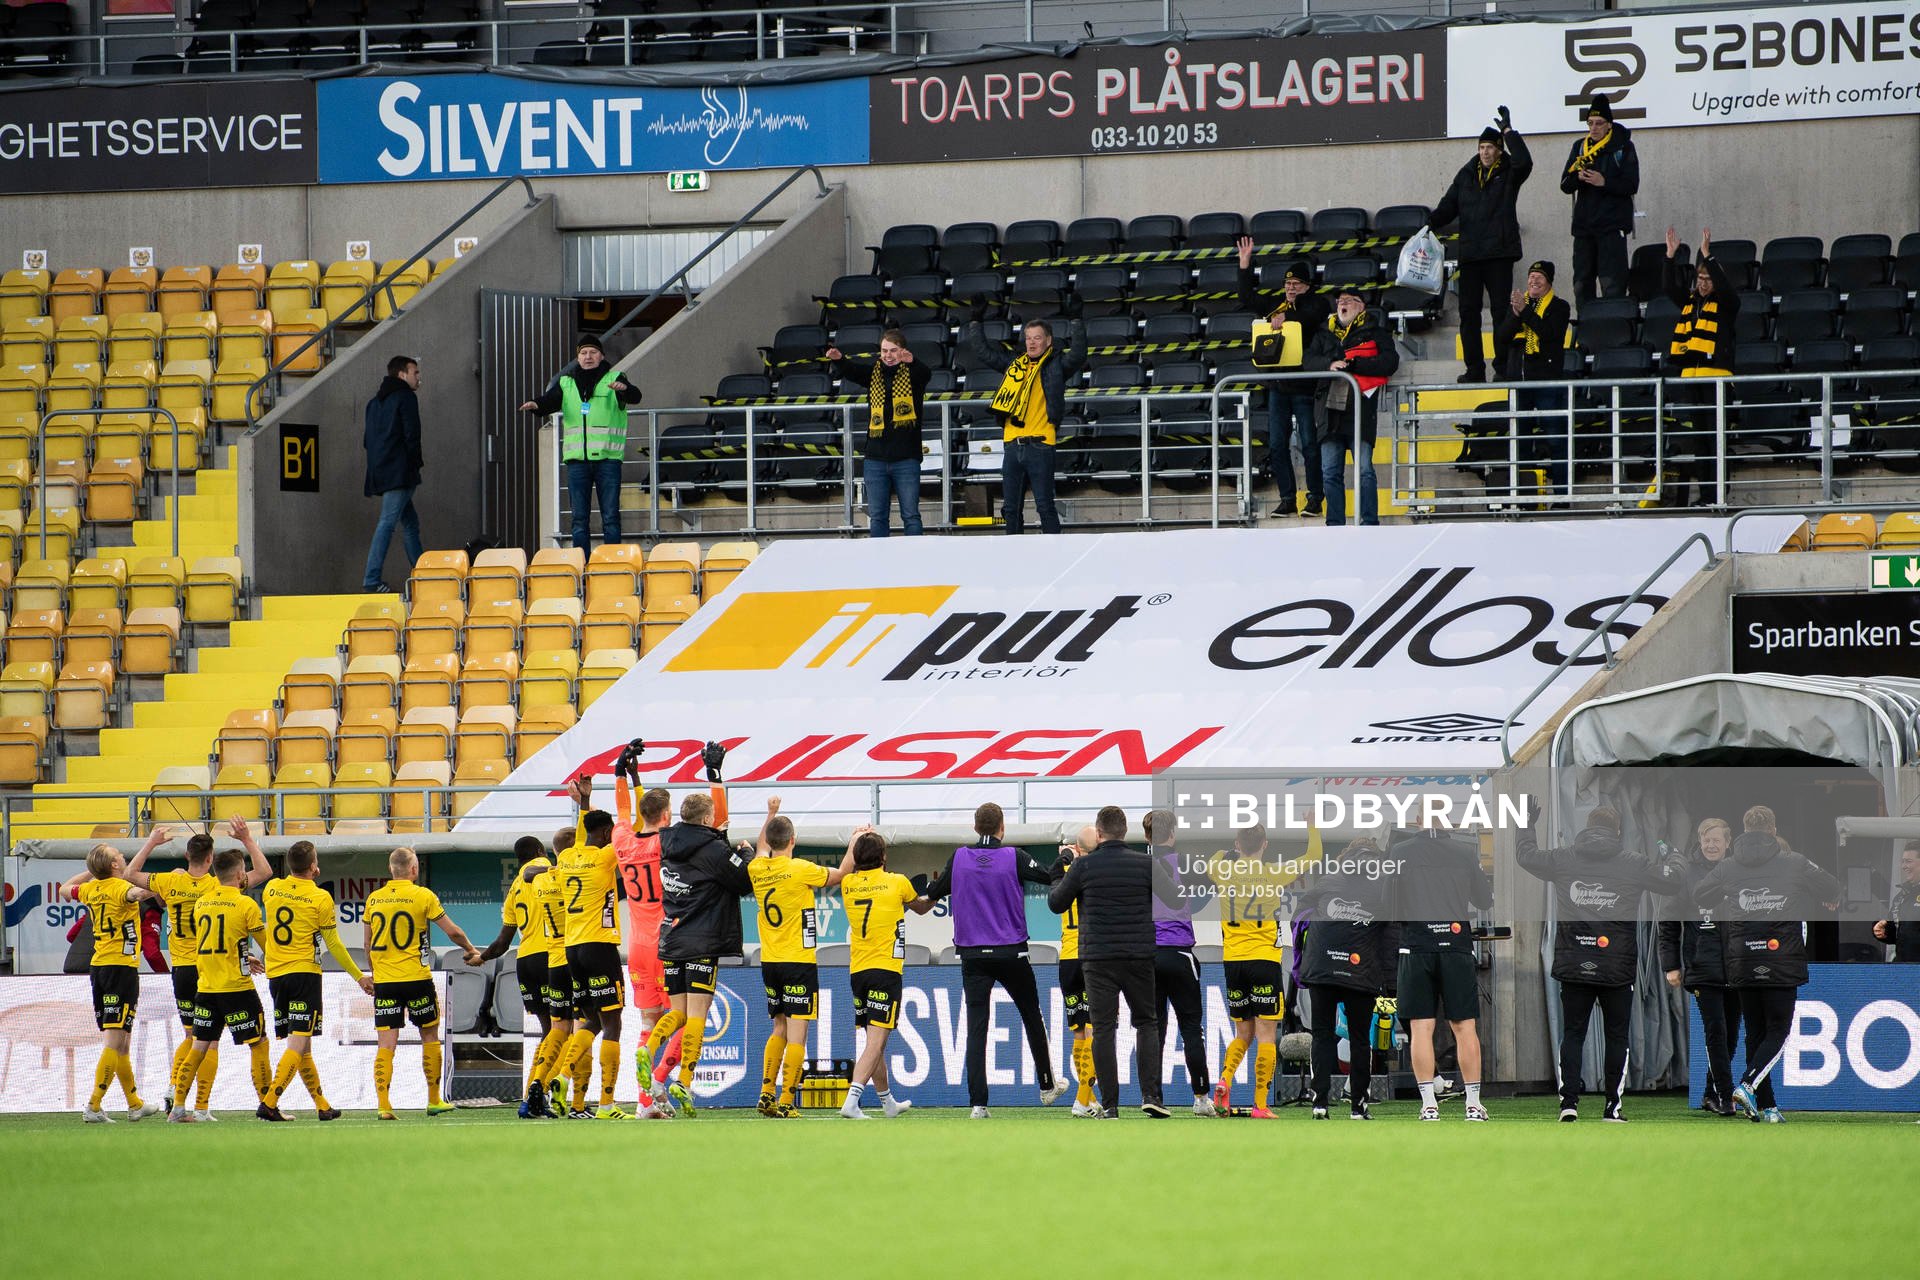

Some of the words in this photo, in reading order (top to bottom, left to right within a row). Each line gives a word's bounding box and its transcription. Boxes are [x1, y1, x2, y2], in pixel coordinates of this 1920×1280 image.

[891, 70, 1075, 124] TOARPS
[1096, 47, 1426, 116] PLÅTSLAGERI
[1692, 87, 1780, 116] Upgrade
[1785, 85, 1831, 106] with
[1836, 81, 1920, 103] comfort
[0, 113, 302, 160] GHETSSERVICE
[377, 81, 643, 177] SILVENT
[1091, 126, 1158, 149] 033-10
[1163, 124, 1189, 147] 20
[1193, 123, 1218, 145] 53
[283, 436, 317, 480] B1
[776, 596, 1142, 681] input
[1207, 566, 1675, 671] ellos
[1749, 620, 1901, 654] Sparbanken
[923, 665, 1079, 681] interiör
[546, 726, 1225, 797] PULSEN
[566, 875, 584, 914] 2
[624, 864, 660, 903] 31
[273, 905, 295, 946] 8
[763, 887, 783, 928] 6
[854, 898, 873, 939] 7
[197, 913, 228, 955] 21
[370, 910, 415, 952] 20
[226, 1012, 247, 1023] EAB
[1782, 999, 1920, 1089] BO
